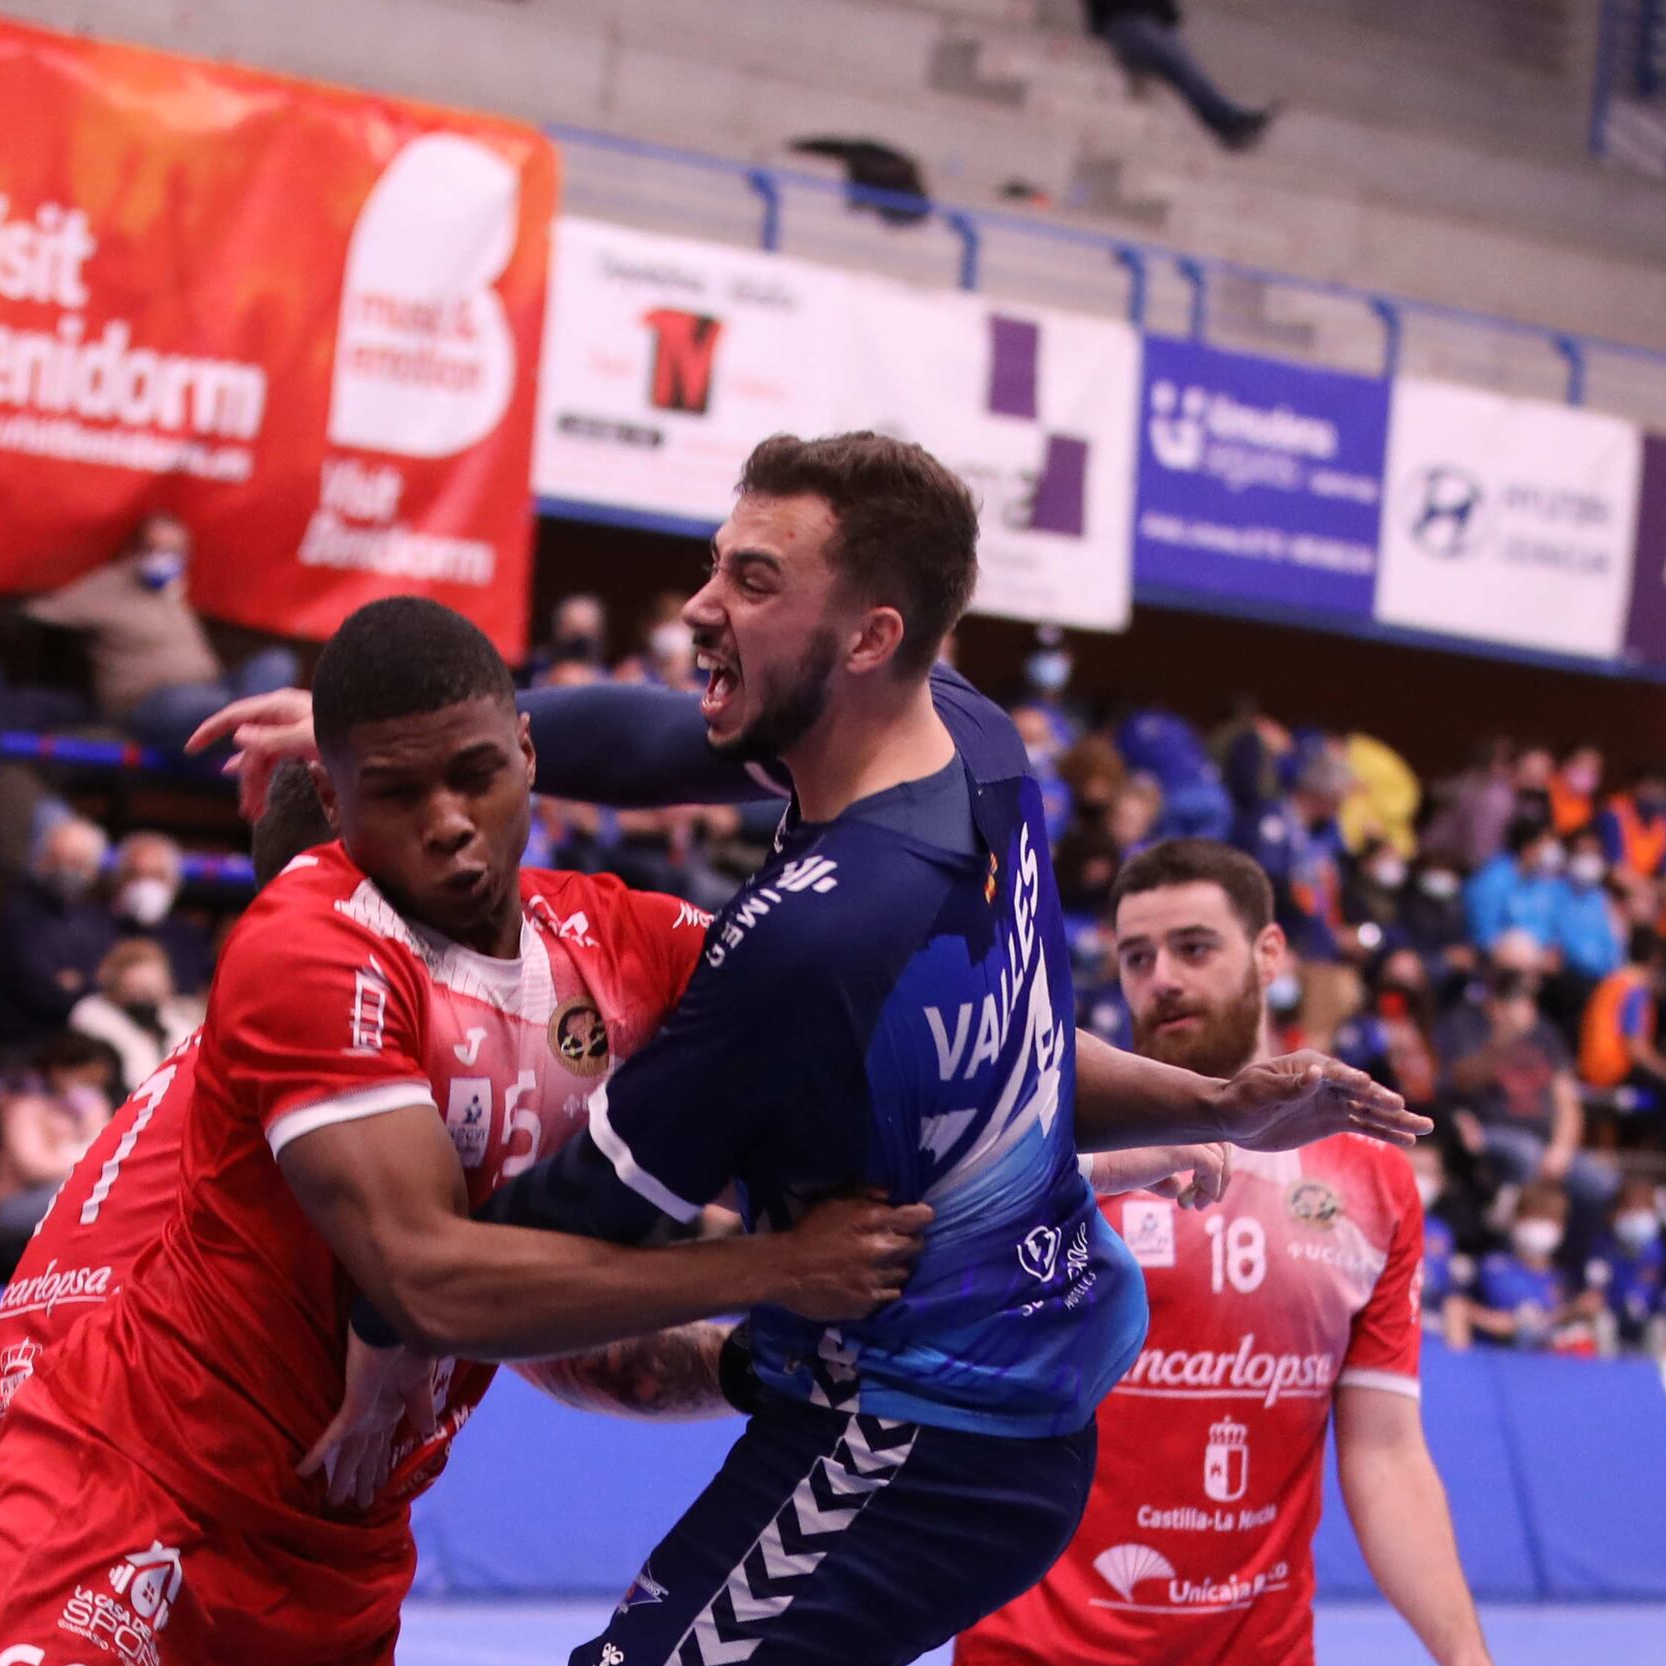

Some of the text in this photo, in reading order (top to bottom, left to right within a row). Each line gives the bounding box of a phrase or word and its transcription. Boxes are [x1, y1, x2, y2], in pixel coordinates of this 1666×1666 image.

[296, 506, 498, 587] Benidorm
[1204, 1214, 1266, 1295] 18
[1120, 1332, 1335, 1409] ncarlopsa
[1137, 1504, 1234, 1532] Castilla-La
[94, 1593, 131, 1627] CASA
